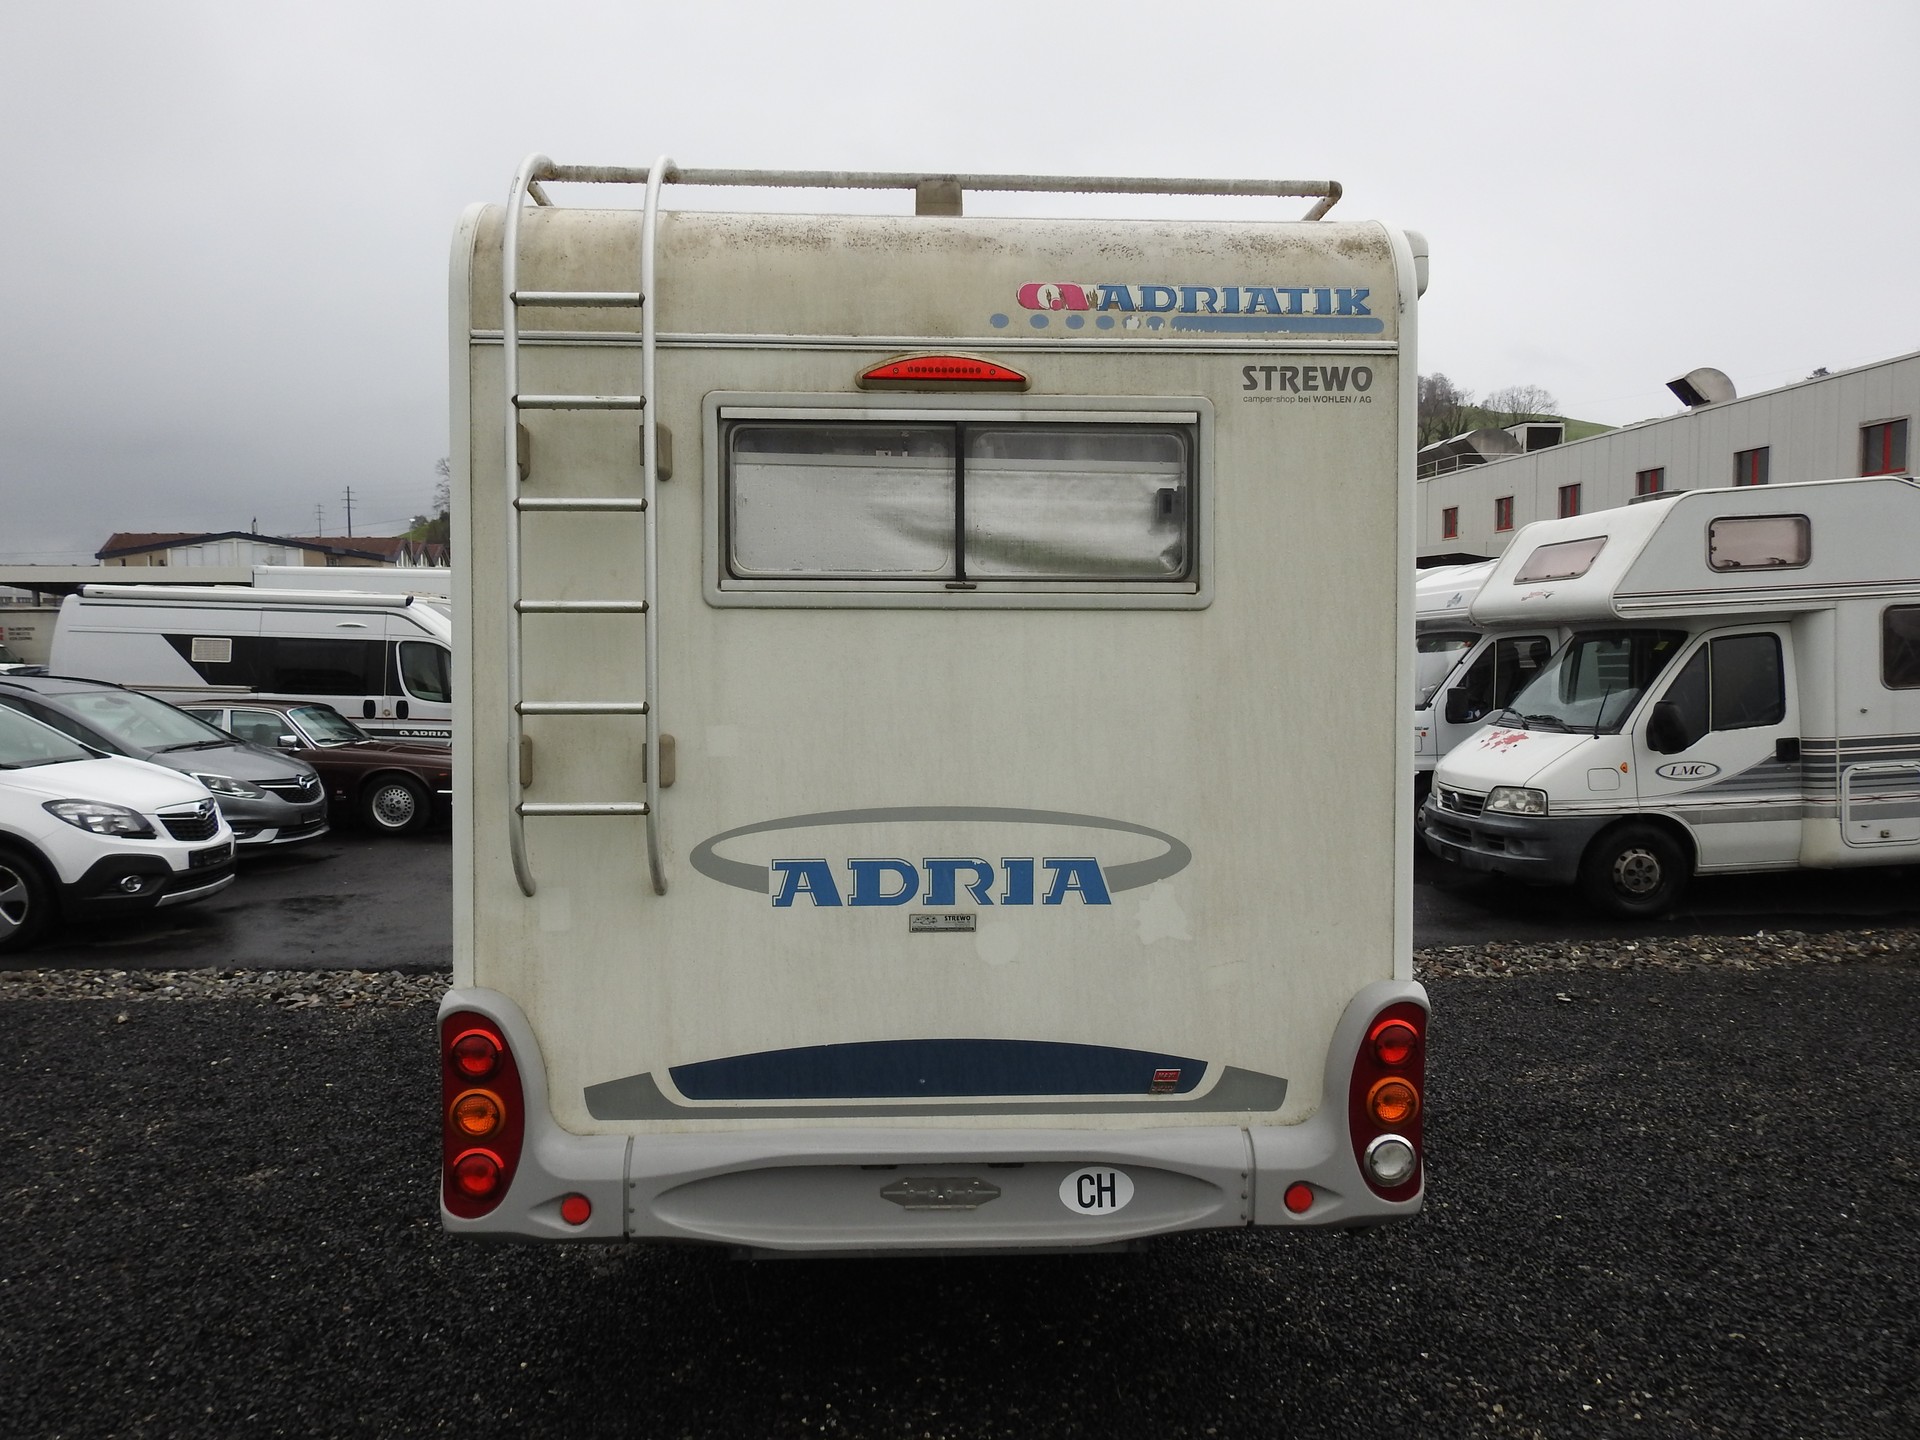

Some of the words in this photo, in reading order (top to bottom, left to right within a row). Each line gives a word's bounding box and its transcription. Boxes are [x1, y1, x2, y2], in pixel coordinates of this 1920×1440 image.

[1096, 284, 1371, 316] ADRIATIK
[1242, 365, 1373, 394] STREWO
[1242, 396, 1296, 404] camper-shop
[1297, 395, 1311, 403] bei
[1670, 765, 1706, 776] LMC
[771, 857, 1112, 907] ADRIA
[1077, 1173, 1116, 1208] CH
